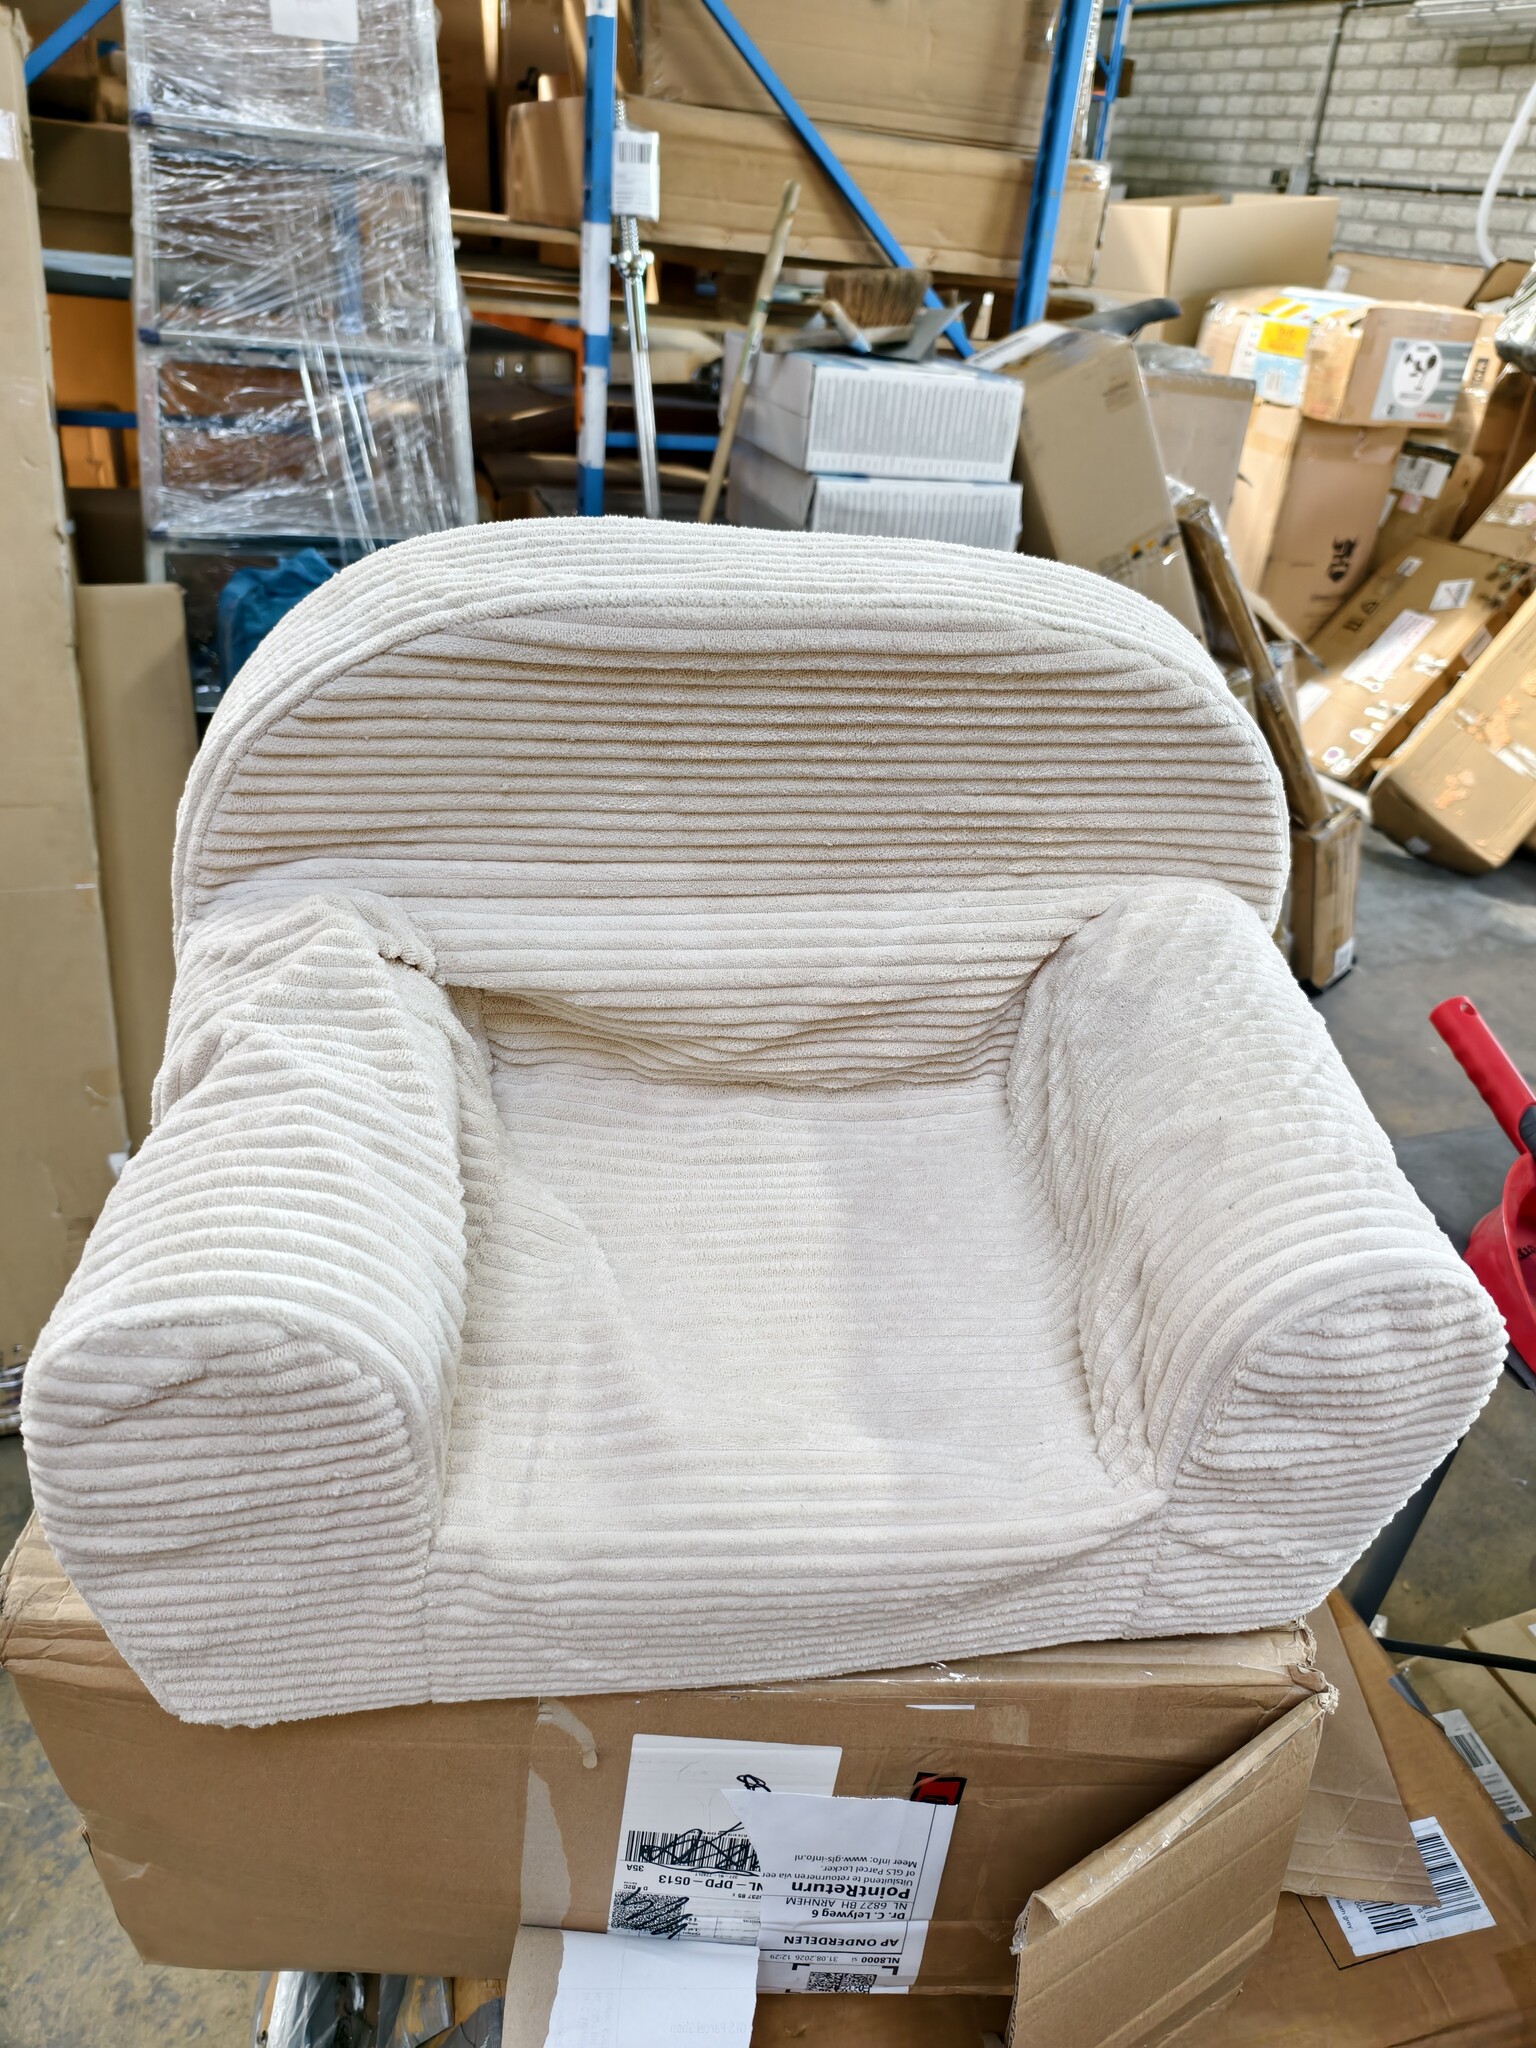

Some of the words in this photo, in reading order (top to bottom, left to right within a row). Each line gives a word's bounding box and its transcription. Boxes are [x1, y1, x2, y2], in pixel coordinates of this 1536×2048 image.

[794, 1855, 868, 1864] www.gls-info.nl
[870, 1857, 891, 1866] info:
[893, 1859, 917, 1867] Meer
[626, 1864, 644, 1872] 35A
[856, 1866, 883, 1874] Parcel
[794, 1873, 850, 1882] retourneren
[852, 1875, 861, 1883] te
[864, 1877, 913, 1886] Uitsluitend
[791, 1882, 910, 1899] PointReturn
[785, 1897, 835, 1906] ARNHEM
[841, 1901, 857, 1909] BH
[893, 1902, 907, 1910] NL
[812, 1910, 818, 1918] 6
[822, 1909, 870, 1918] Lelyweg
[889, 1912, 905, 1920] Dr.
[783, 1936, 876, 1947] ONDERDELEN
[880, 1939, 899, 1947] AP
